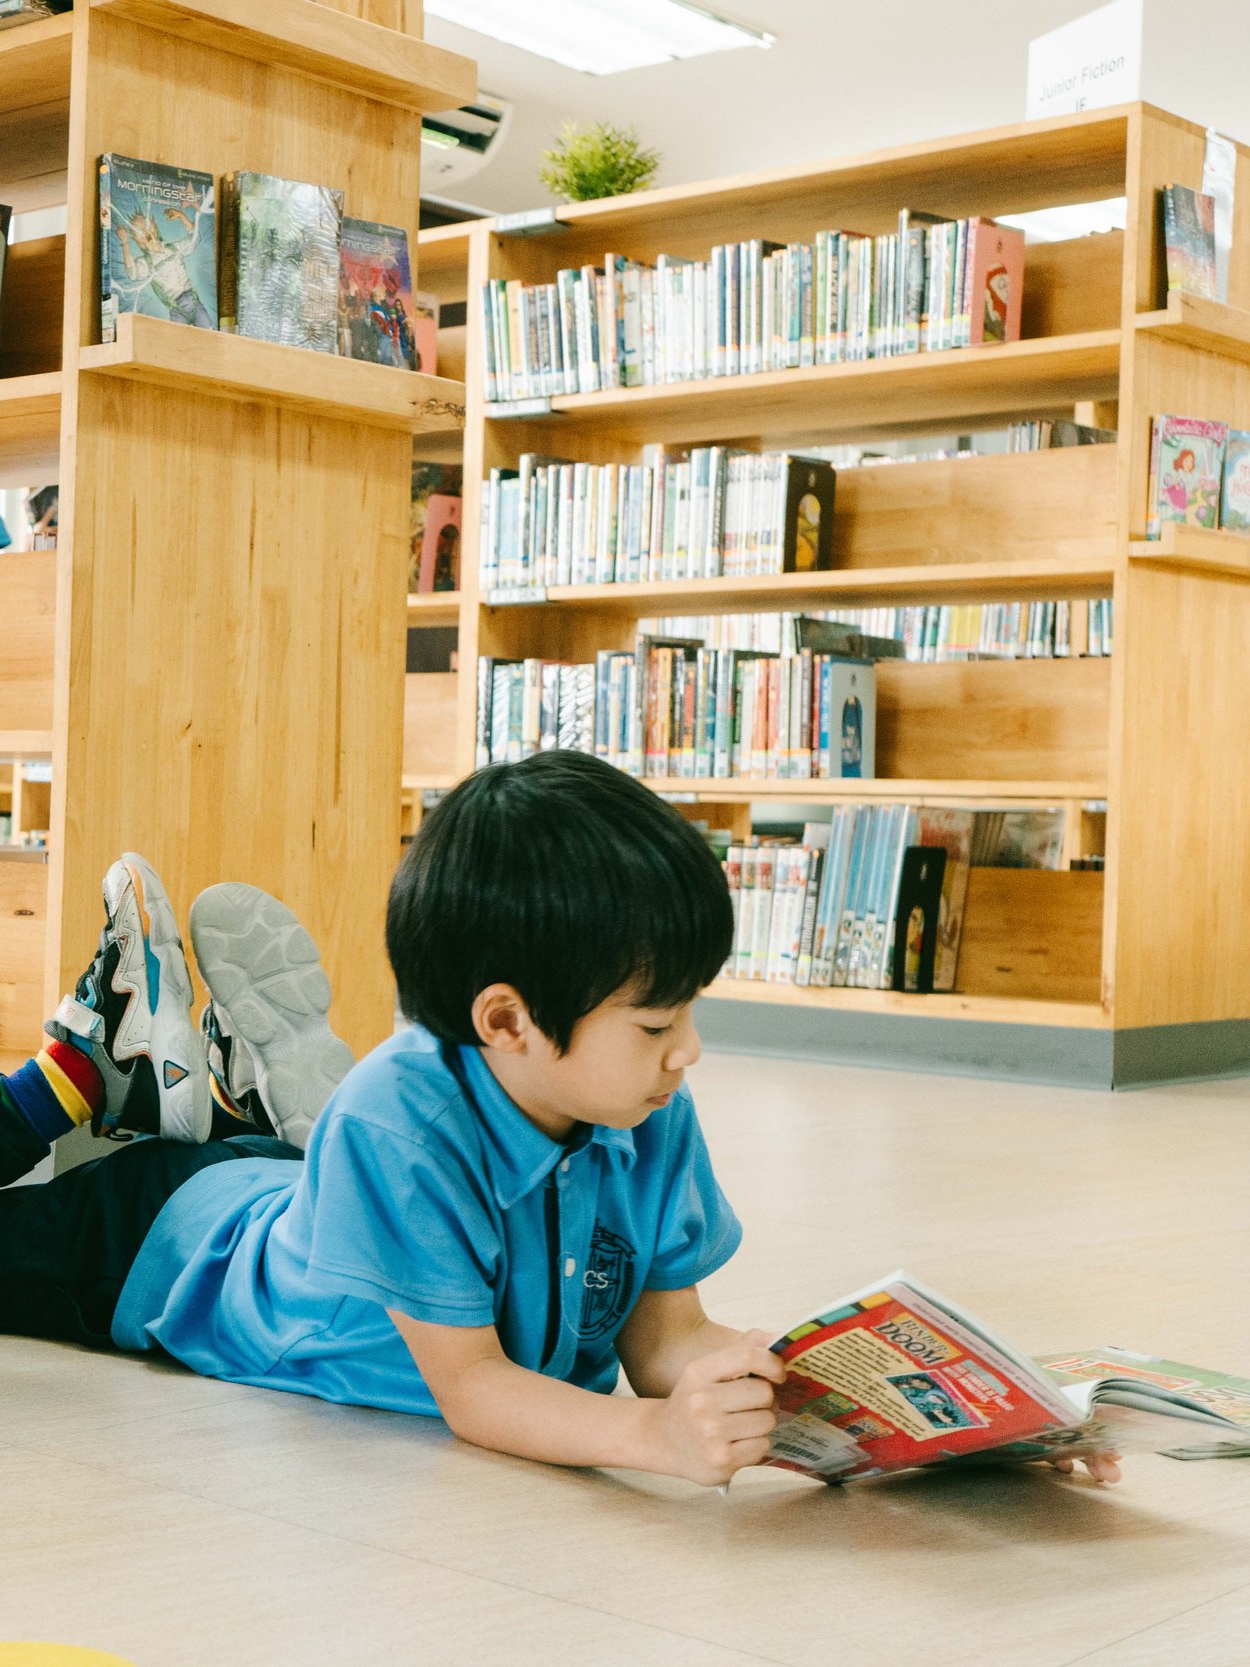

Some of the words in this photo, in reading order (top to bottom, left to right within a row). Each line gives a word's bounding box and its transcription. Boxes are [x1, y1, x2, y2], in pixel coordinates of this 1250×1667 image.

[1039, 73, 1078, 101] Junior
[1081, 55, 1125, 83] Fiction
[874, 1321, 946, 1364] DOOM
